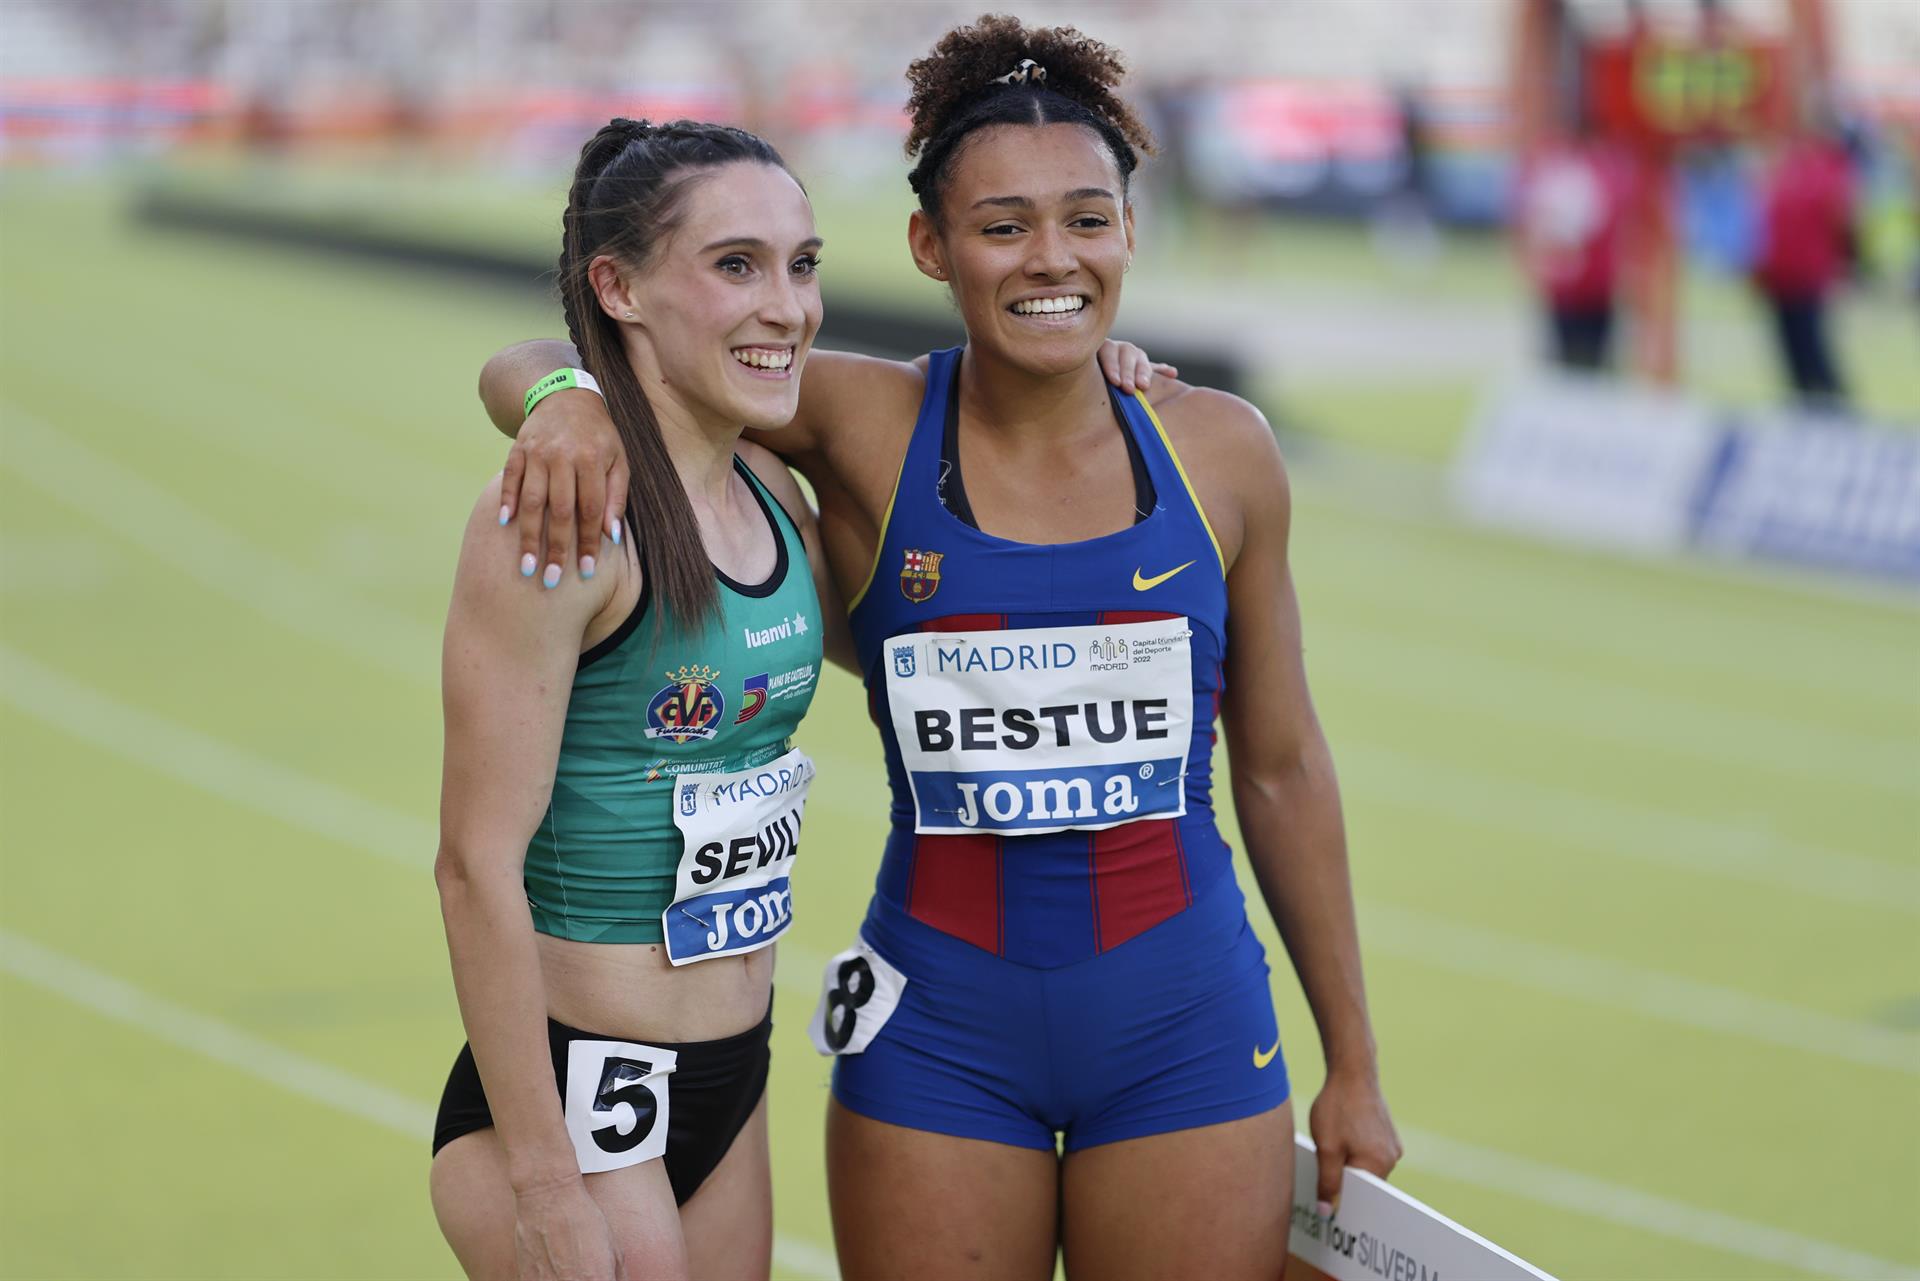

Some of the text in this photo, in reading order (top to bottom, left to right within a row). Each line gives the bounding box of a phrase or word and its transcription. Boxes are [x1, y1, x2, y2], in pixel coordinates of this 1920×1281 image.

[744, 616, 792, 649] luanvi
[1132, 638, 1157, 648] Capital
[937, 643, 1077, 673] MADRID
[1132, 655, 1152, 664] 2022
[1144, 645, 1172, 655] Deporte
[1089, 662, 1129, 672] MADRID
[914, 698, 1169, 752] BESTUE
[664, 760, 725, 773] COMUNITAT
[713, 763, 804, 806] MADRID
[825, 956, 875, 1051] 8
[590, 1056, 658, 1153] 5
[1357, 1231, 1417, 1281] SILVER
